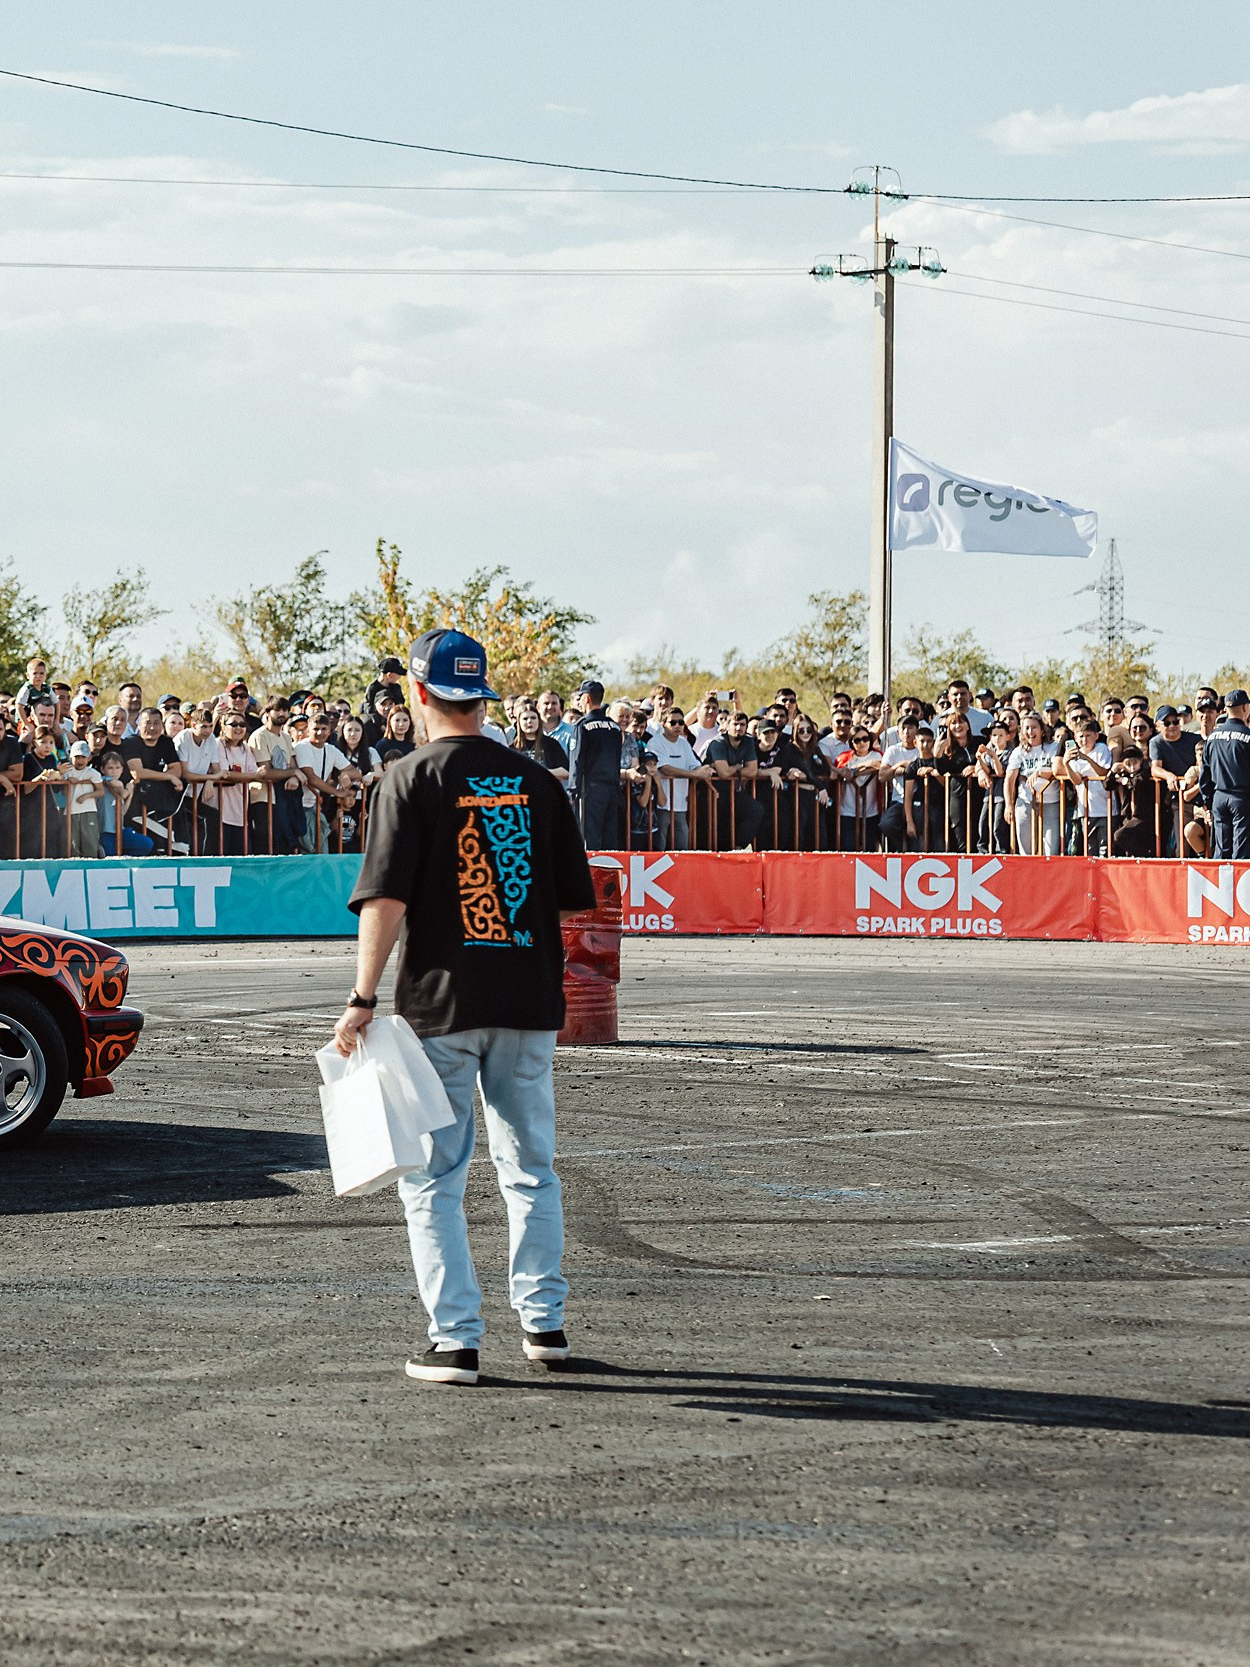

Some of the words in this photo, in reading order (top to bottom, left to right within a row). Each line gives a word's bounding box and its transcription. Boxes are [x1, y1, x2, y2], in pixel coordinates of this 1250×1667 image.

[938, 480, 1061, 521] reg
[855, 857, 1003, 913] NGK
[856, 916, 926, 933] SPARK
[930, 918, 1003, 934] PLUGS
